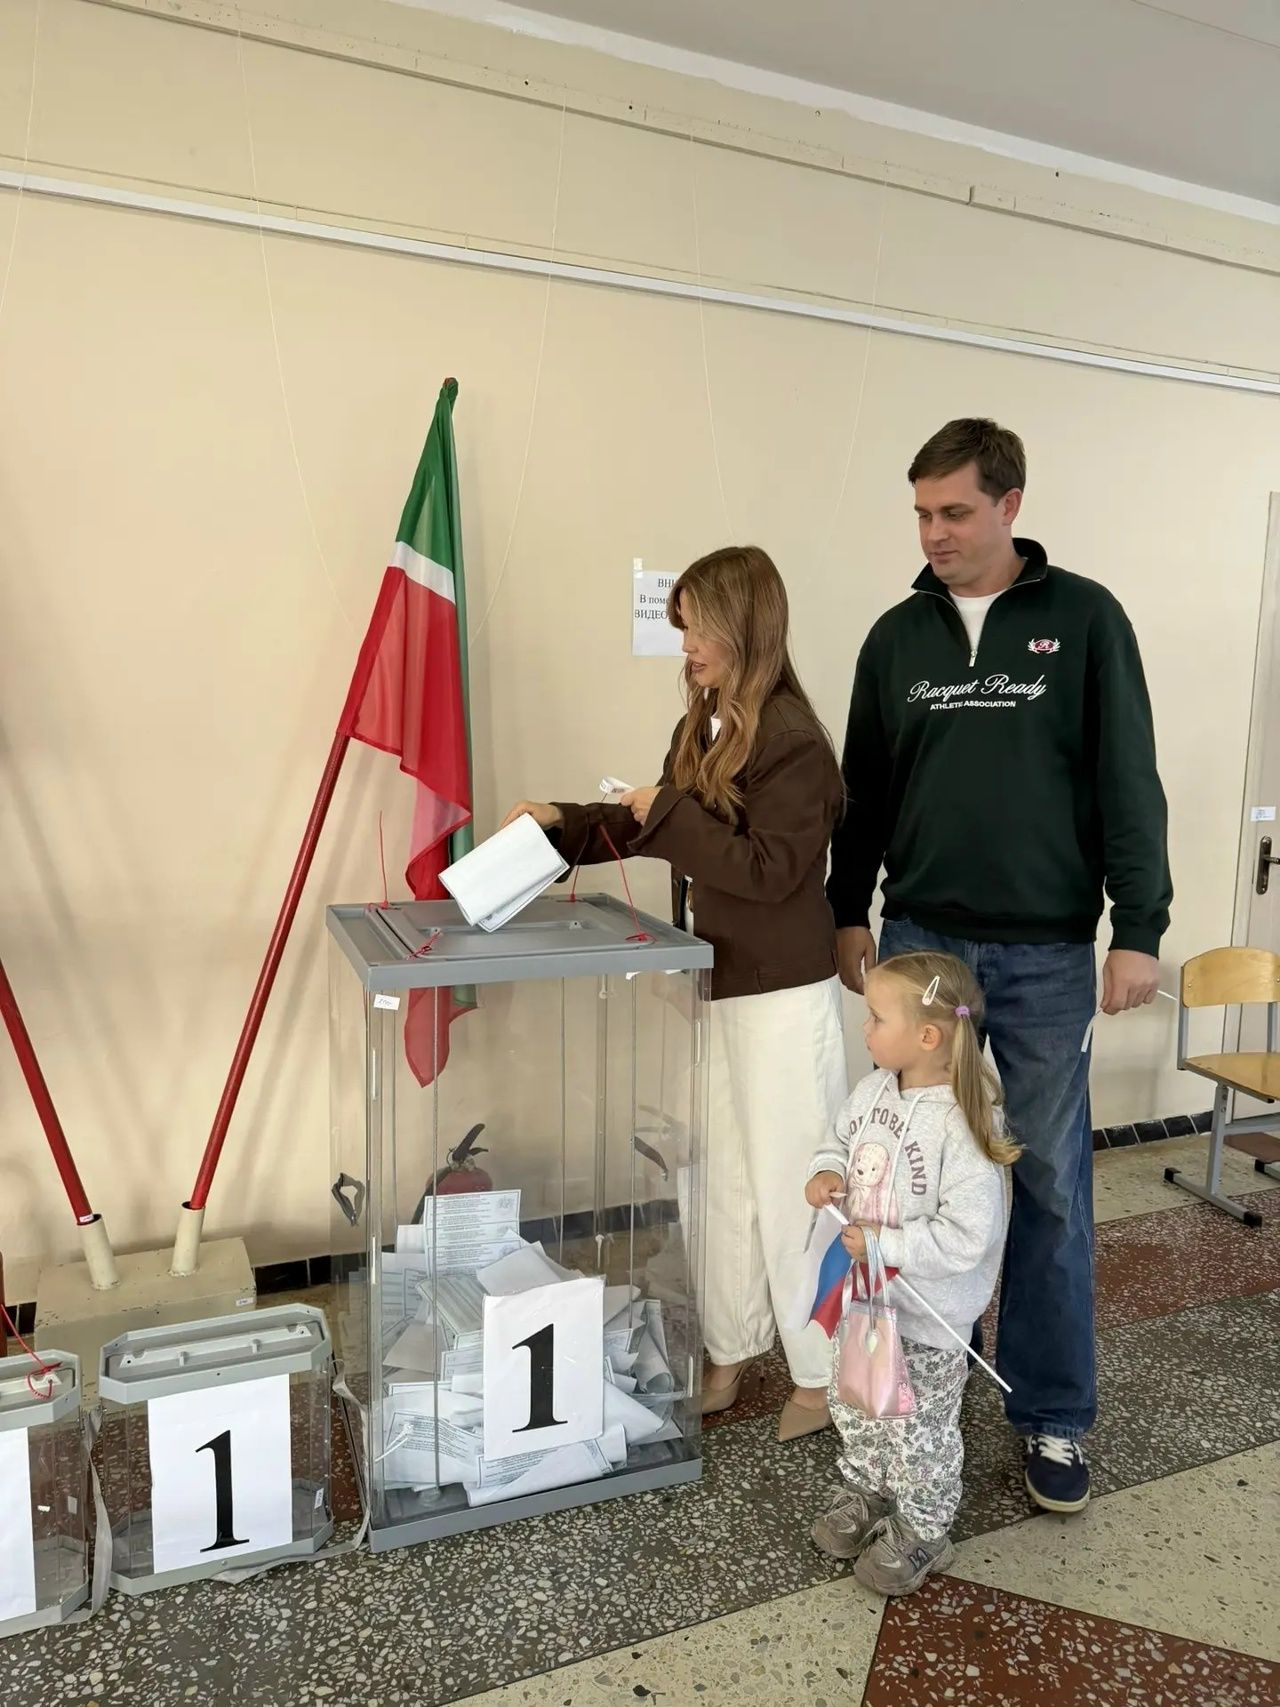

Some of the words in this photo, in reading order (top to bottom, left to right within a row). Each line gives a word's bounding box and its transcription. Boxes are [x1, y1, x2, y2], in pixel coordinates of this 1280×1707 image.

[640, 594, 646, 603] В
[648, 597, 668, 605] пом
[634, 609, 669, 620] ВИДЕО
[907, 679, 980, 703] Racquet
[981, 674, 1047, 700] Ready
[963, 700, 1017, 708] ASSOCIATION
[904, 1140, 927, 1196] KIND
[511, 1322, 568, 1433] 1
[195, 1429, 250, 1553] 1
